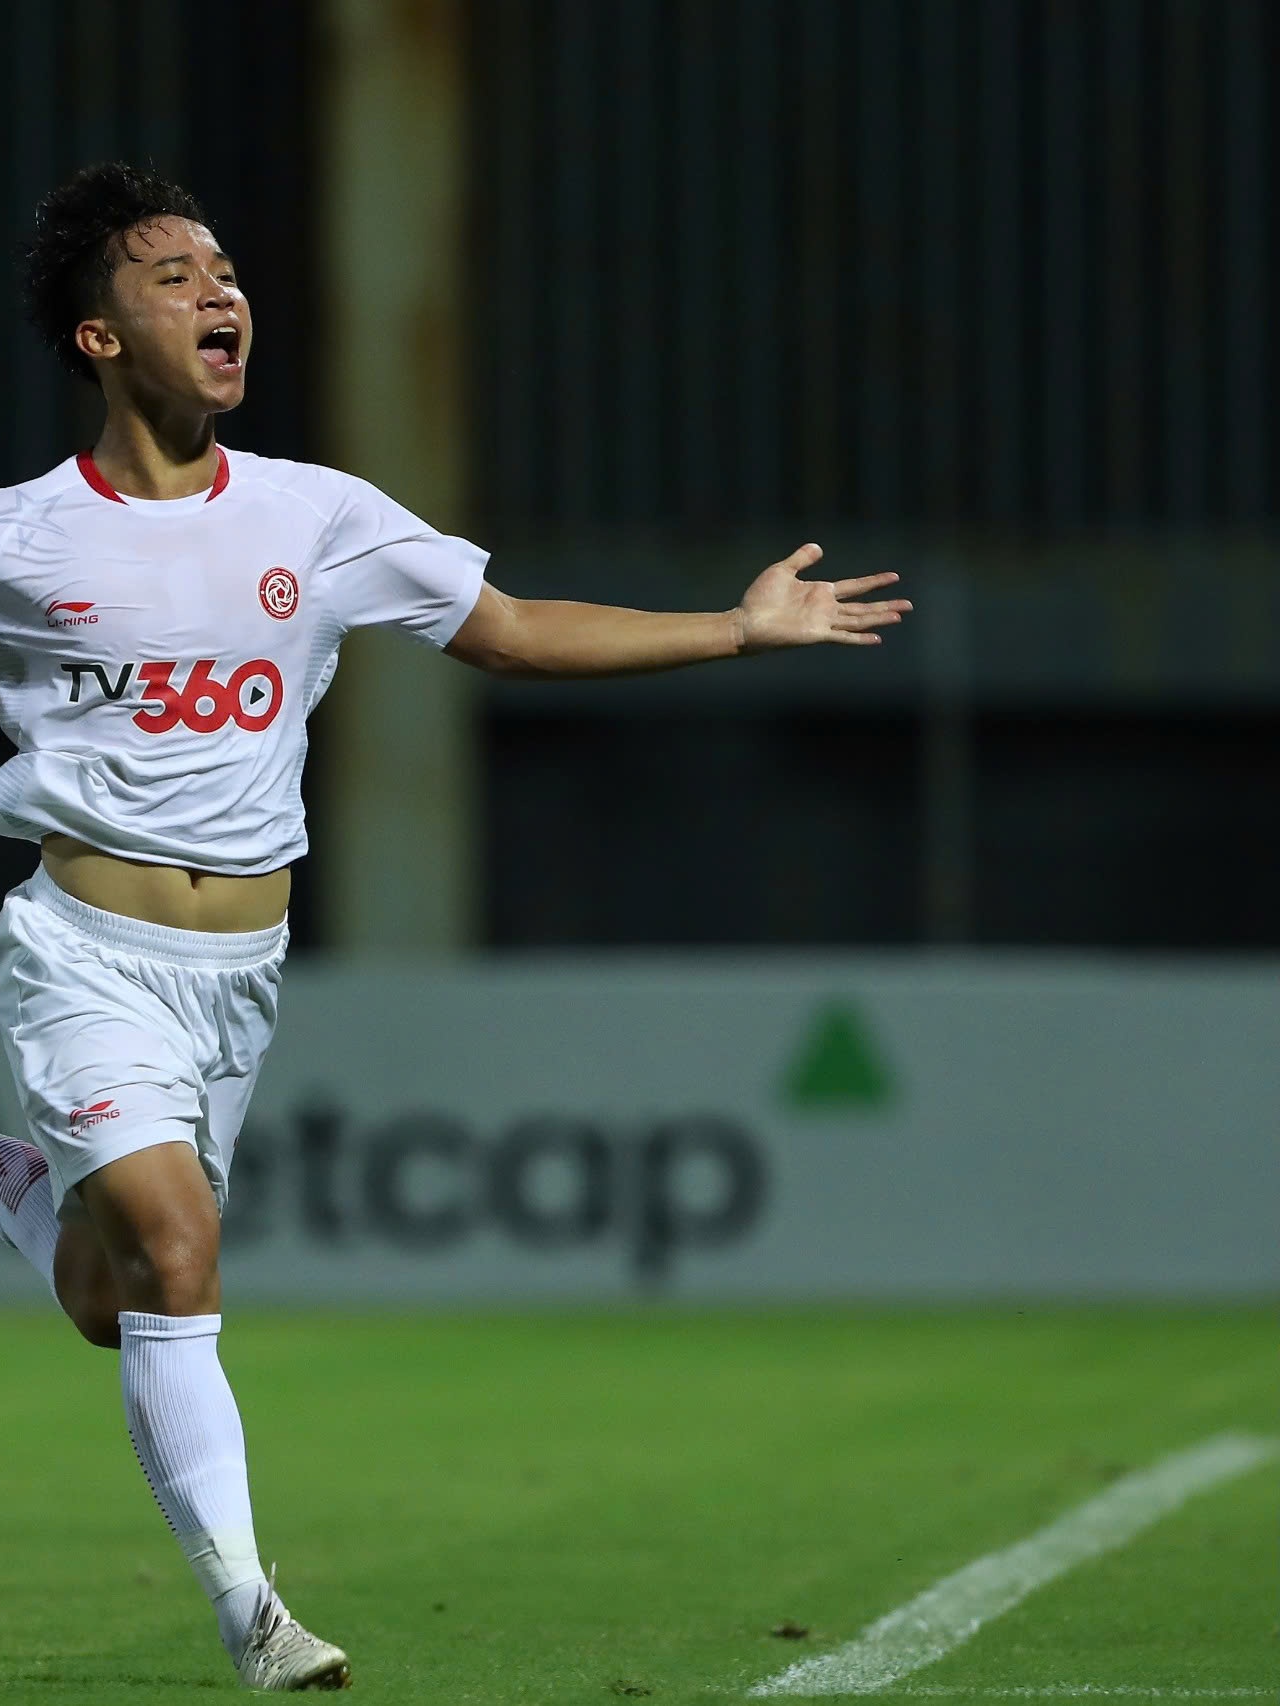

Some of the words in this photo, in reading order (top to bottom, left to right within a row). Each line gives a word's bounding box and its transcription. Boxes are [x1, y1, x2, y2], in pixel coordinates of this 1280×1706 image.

[47, 614, 99, 628] LI-NING
[60, 657, 284, 735] TV360
[71, 1108, 121, 1137] LI-NING
